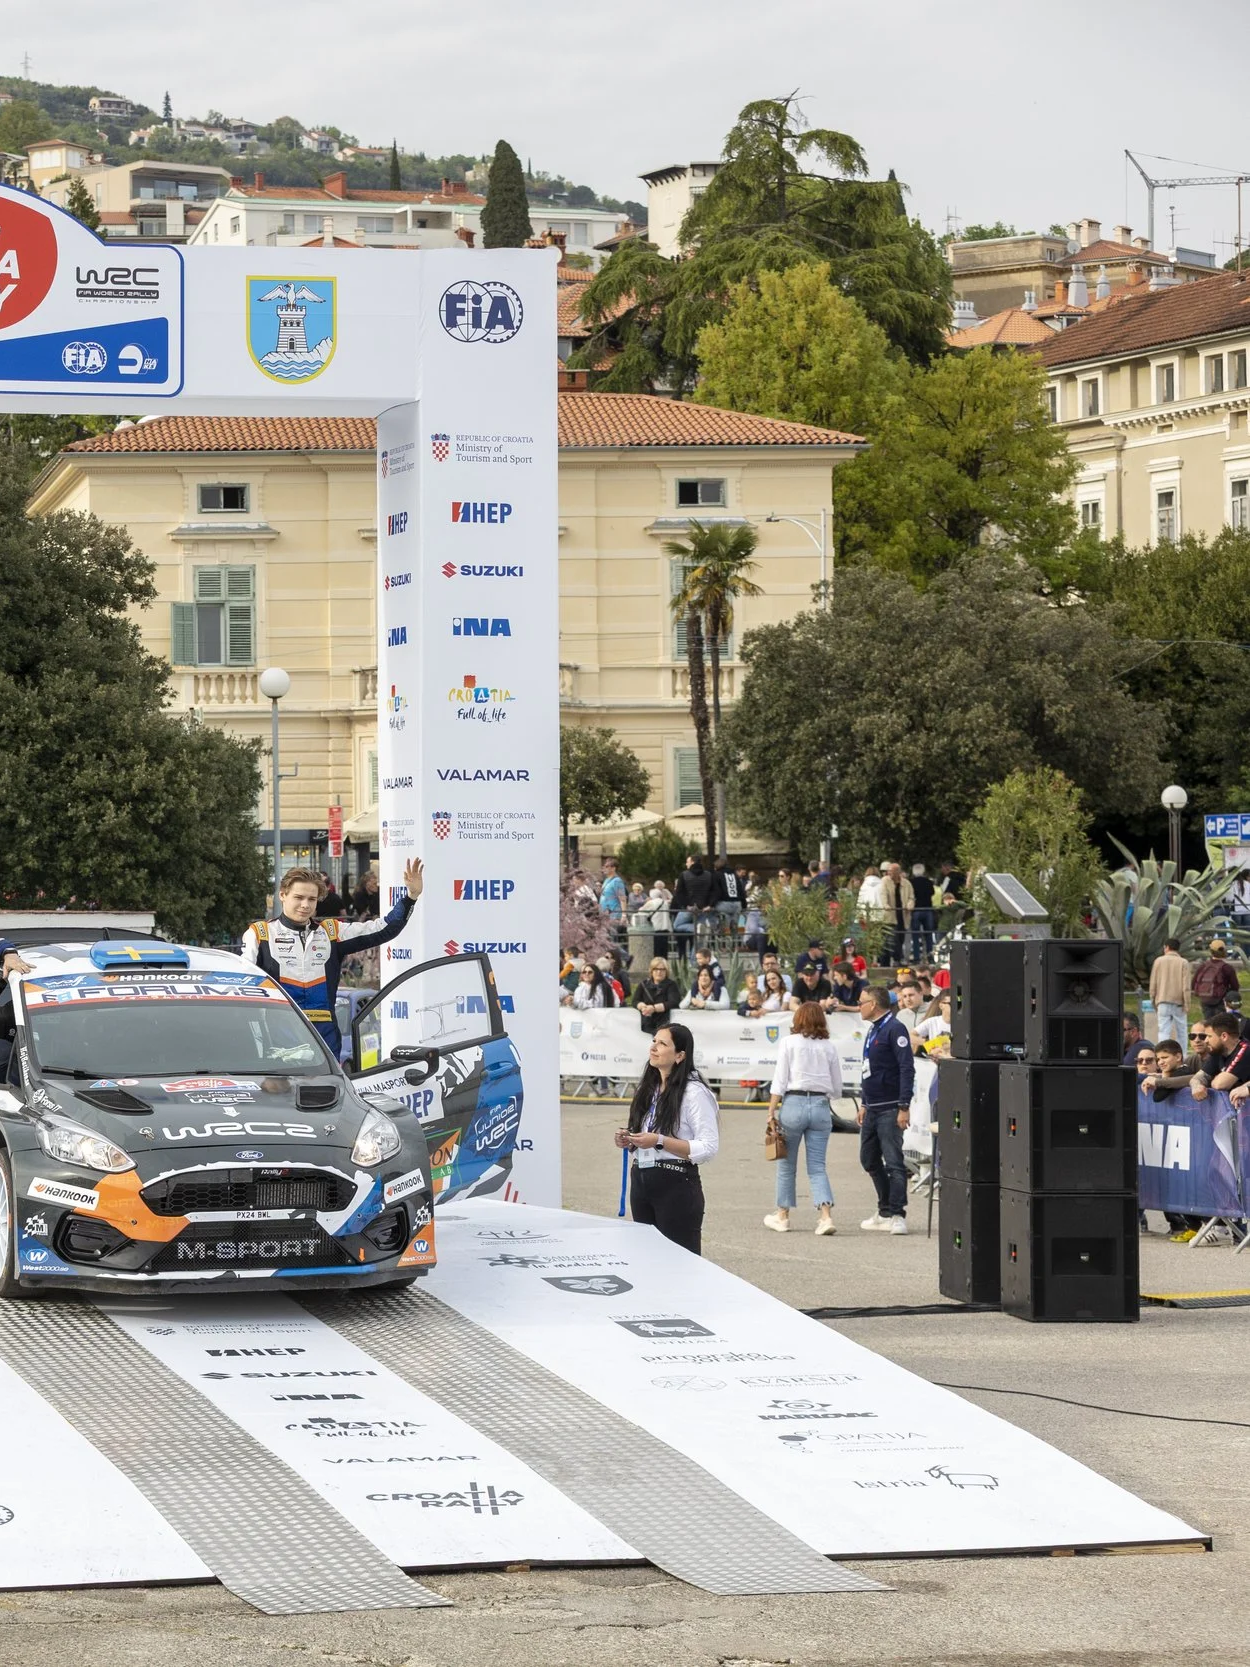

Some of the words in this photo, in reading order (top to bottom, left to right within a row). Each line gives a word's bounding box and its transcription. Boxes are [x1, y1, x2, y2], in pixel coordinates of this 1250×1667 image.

[75, 266, 159, 287] WRC
[456, 434, 493, 443] REPUBLIC
[503, 436, 534, 444] CROATIA
[456, 443, 492, 454] Ministry
[493, 444, 504, 453] of
[456, 453, 491, 463] Tourism
[492, 455, 509, 463] and
[510, 455, 532, 465] Sport
[472, 502, 512, 524] HEP
[460, 564, 524, 577] SUZUKI
[390, 573, 412, 588] SUZUKI
[448, 687, 514, 704] CROATIA
[436, 768, 530, 782] VALAMAR
[383, 776, 414, 790] VALAMAR
[457, 812, 495, 820] REPUBLIC
[504, 812, 535, 820] CROATIA
[457, 821, 494, 832] Ministry
[495, 821, 505, 830] of
[457, 831, 493, 840] Tourism
[494, 831, 511, 840] and
[512, 831, 535, 842] Sport
[474, 879, 515, 901] HEP
[391, 948, 412, 960] SUZUKI
[463, 941, 527, 954] SUZUKI
[77, 985, 270, 999] FORUM8
[478, 1104, 514, 1134] JUNIOR
[162, 1121, 318, 1141] WRC2
[476, 1112, 519, 1151] WRC
[1138, 1122, 1191, 1171] NA
[239, 1151, 261, 1160] Ford
[236, 1211, 255, 1219] PX24
[239, 1347, 307, 1357] HEP
[240, 1370, 378, 1379] SUZUKI
[757, 1412, 879, 1421] KARLOVAC
[816, 1431, 929, 1442] OPATIJA
[322, 1455, 481, 1464] VALAMAR
[851, 1479, 931, 1490] Istria
[366, 1485, 525, 1501] CROATIA
[420, 1499, 525, 1512] RALLY
